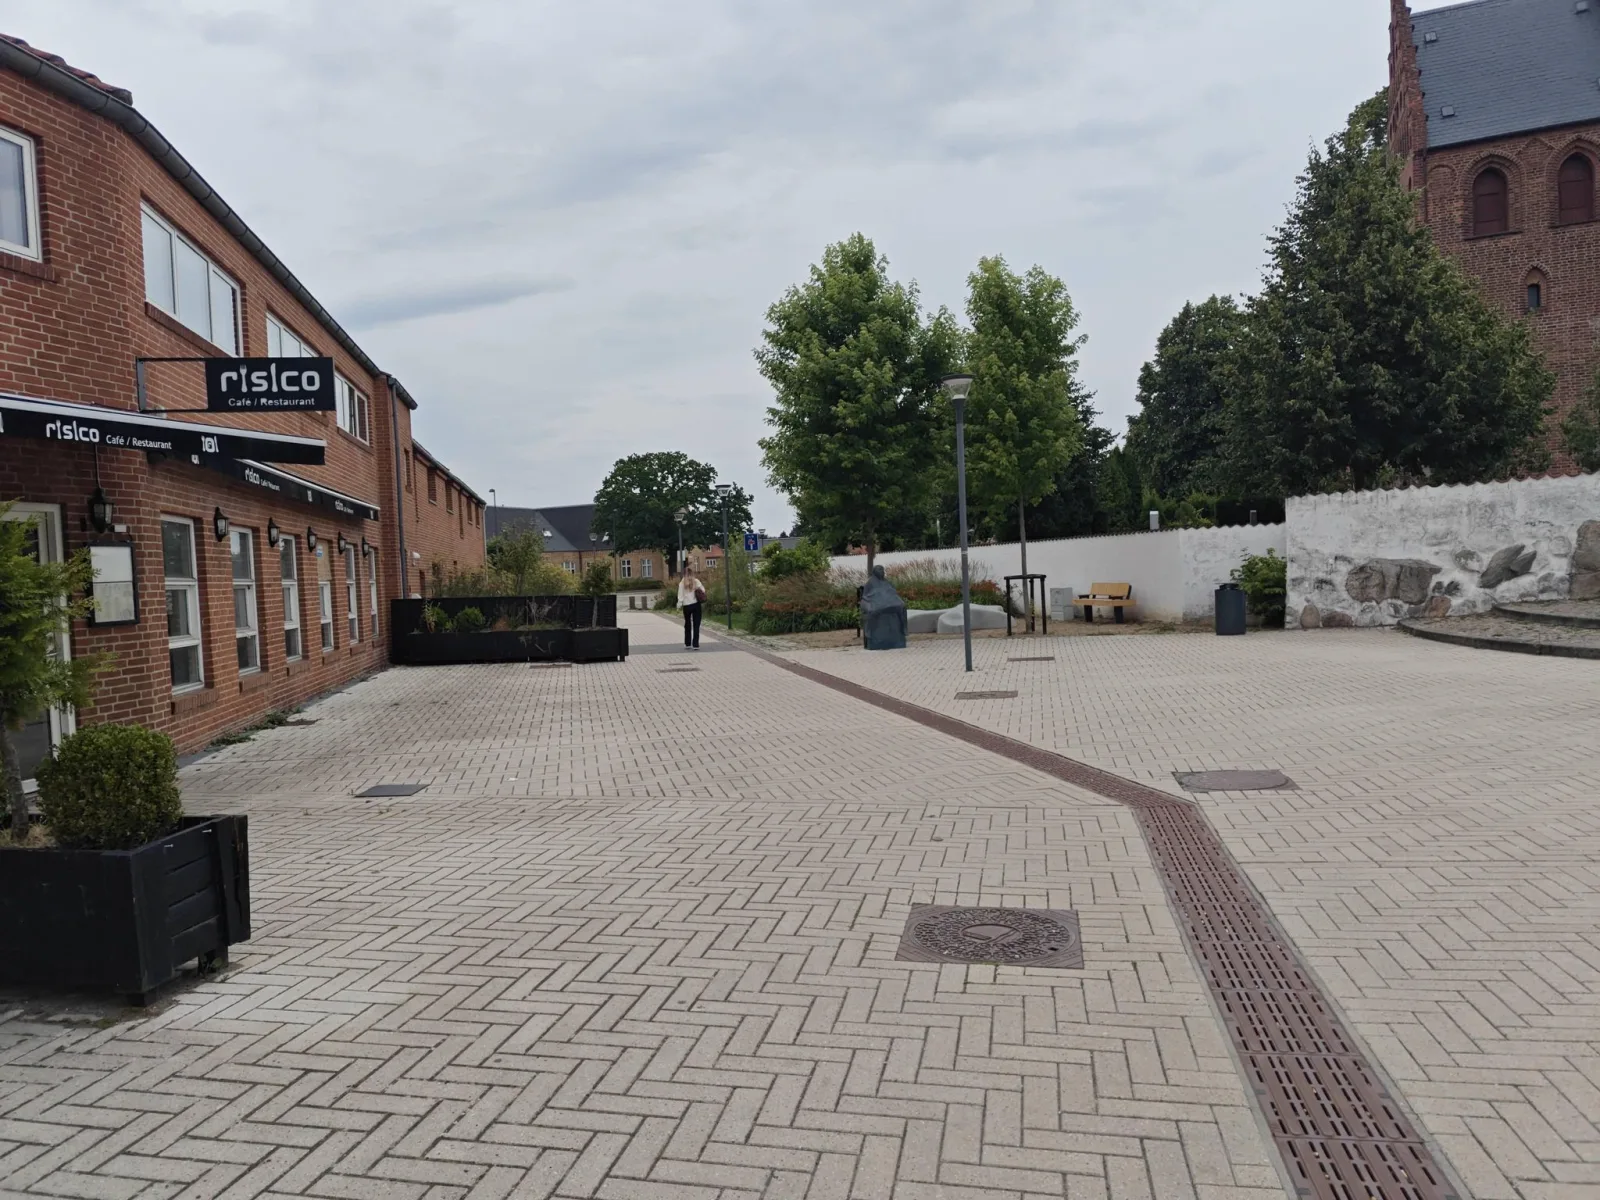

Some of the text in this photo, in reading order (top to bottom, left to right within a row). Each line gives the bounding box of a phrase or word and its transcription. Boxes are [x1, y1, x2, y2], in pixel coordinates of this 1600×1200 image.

[220, 362, 320, 393] risico
[228, 398, 252, 407] Café
[260, 398, 315, 406] Restaurant
[46, 420, 100, 443] risico
[105, 435, 125, 446] Café
[132, 437, 172, 450] Restaurant
